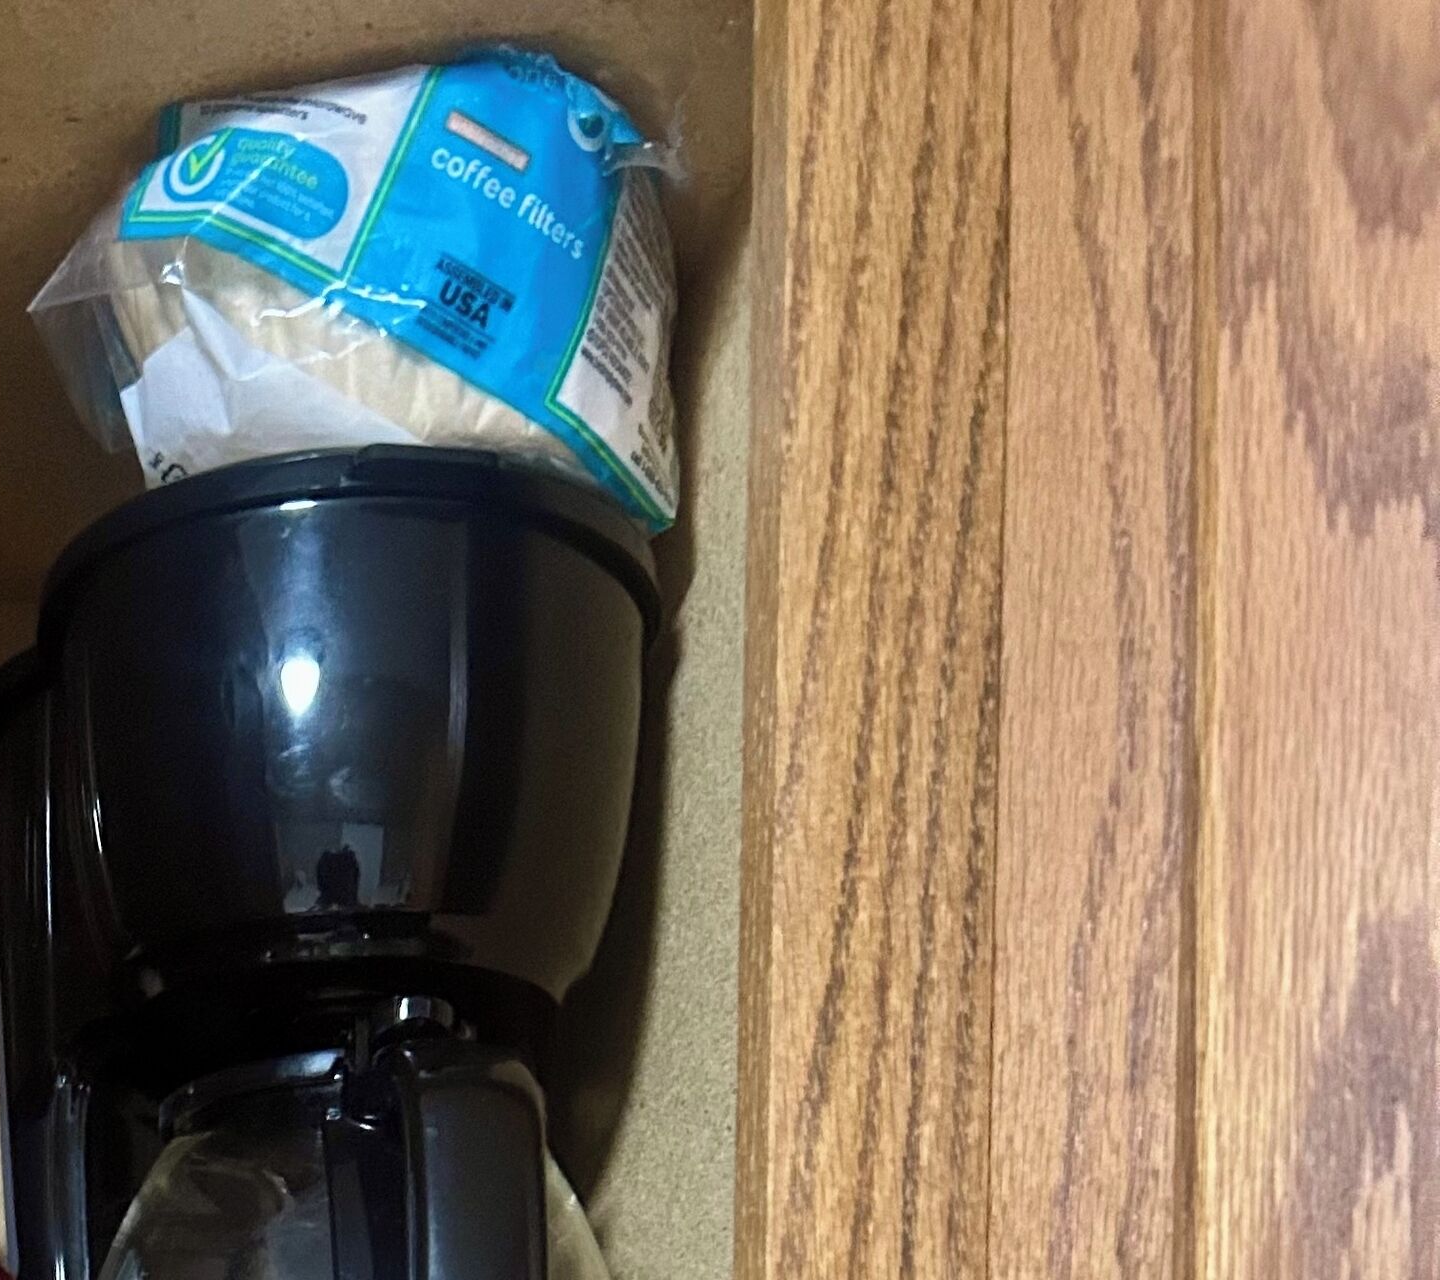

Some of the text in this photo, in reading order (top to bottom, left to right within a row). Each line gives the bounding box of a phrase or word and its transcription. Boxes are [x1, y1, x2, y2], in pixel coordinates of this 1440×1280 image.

[431, 147, 585, 260] coffee filters
[438, 278, 491, 330] USA
